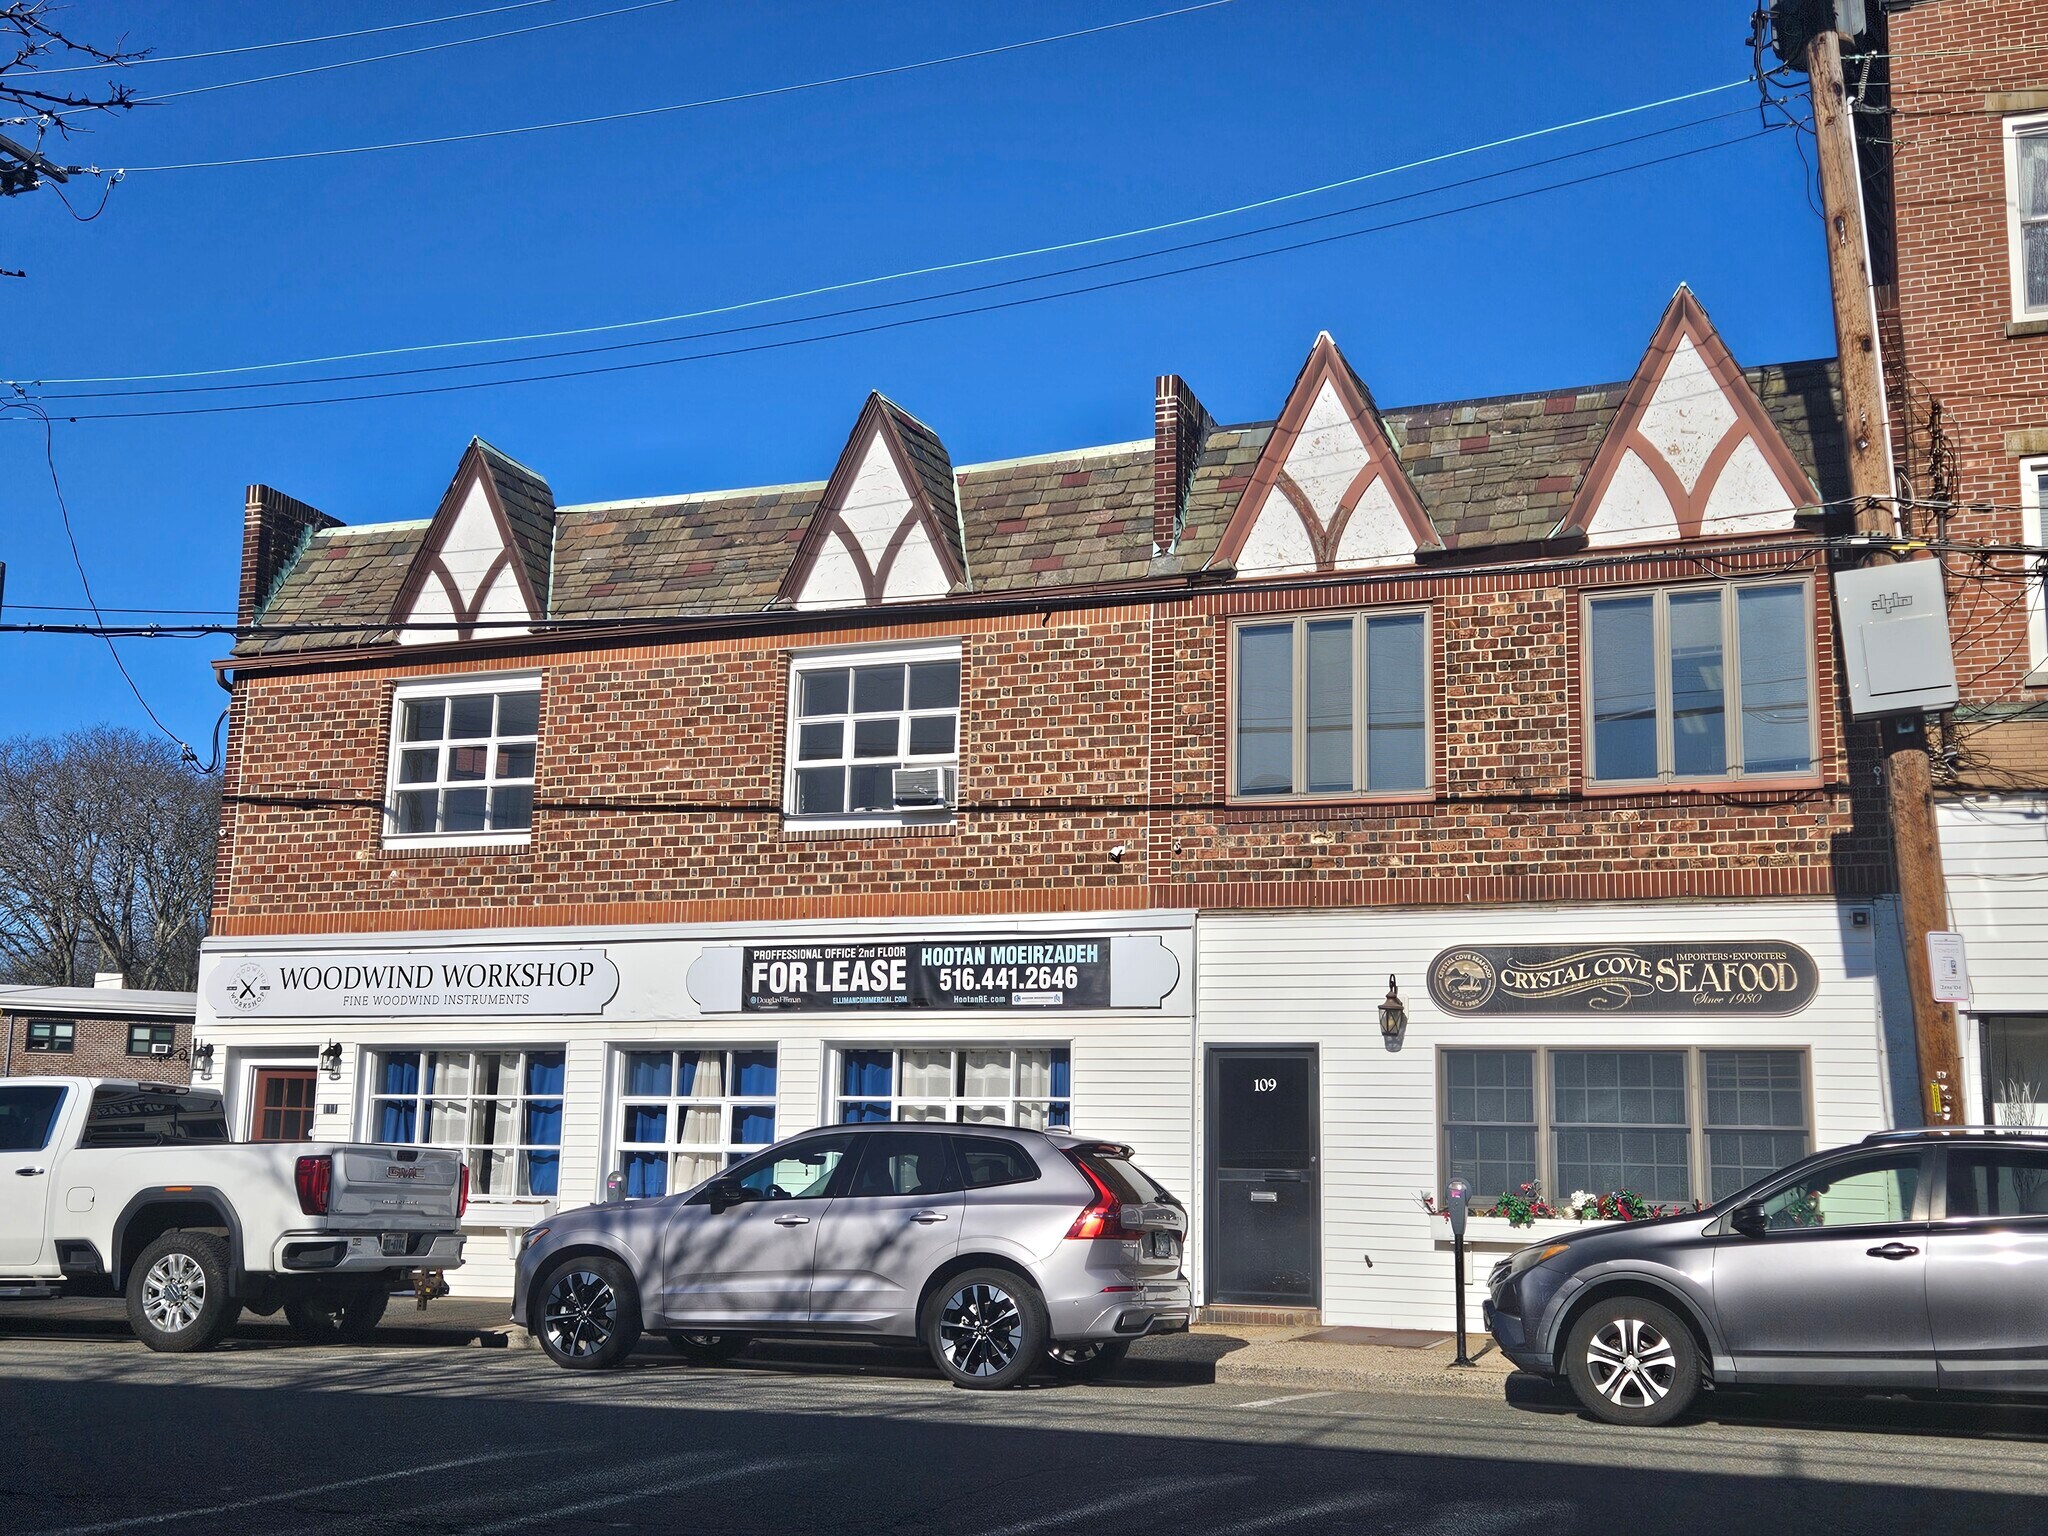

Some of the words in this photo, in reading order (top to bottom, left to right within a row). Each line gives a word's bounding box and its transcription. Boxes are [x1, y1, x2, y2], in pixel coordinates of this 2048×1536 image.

[753, 949, 823, 960] PROFFESSIONAL
[825, 948, 856, 959] OFFICE
[858, 947, 874, 958] 2nd
[877, 946, 906, 957] FLOOR
[921, 946, 985, 966] HOOTAN
[990, 944, 1098, 965] MOEIRZADEH
[280, 965, 434, 990] WOODWIND
[442, 962, 594, 988] WORKSHOP
[751, 961, 808, 993] FOR
[815, 959, 907, 992] LEASE
[939, 965, 1078, 991] 516.441.2646
[1500, 963, 1591, 989] CRYSTAL
[1594, 957, 1652, 978] COVE
[1655, 958, 1798, 992] SEAFOOD
[343, 995, 369, 1006] FINE
[373, 994, 440, 1006] WOODWIND
[443, 993, 530, 1005] INSTRUMENTS
[953, 995, 1006, 1003] HootanRE.com
[1693, 991, 1723, 1006] Since
[1729, 992, 1762, 1005] 1980
[1254, 1078, 1277, 1092] 109
[386, 1166, 425, 1179] GMC
